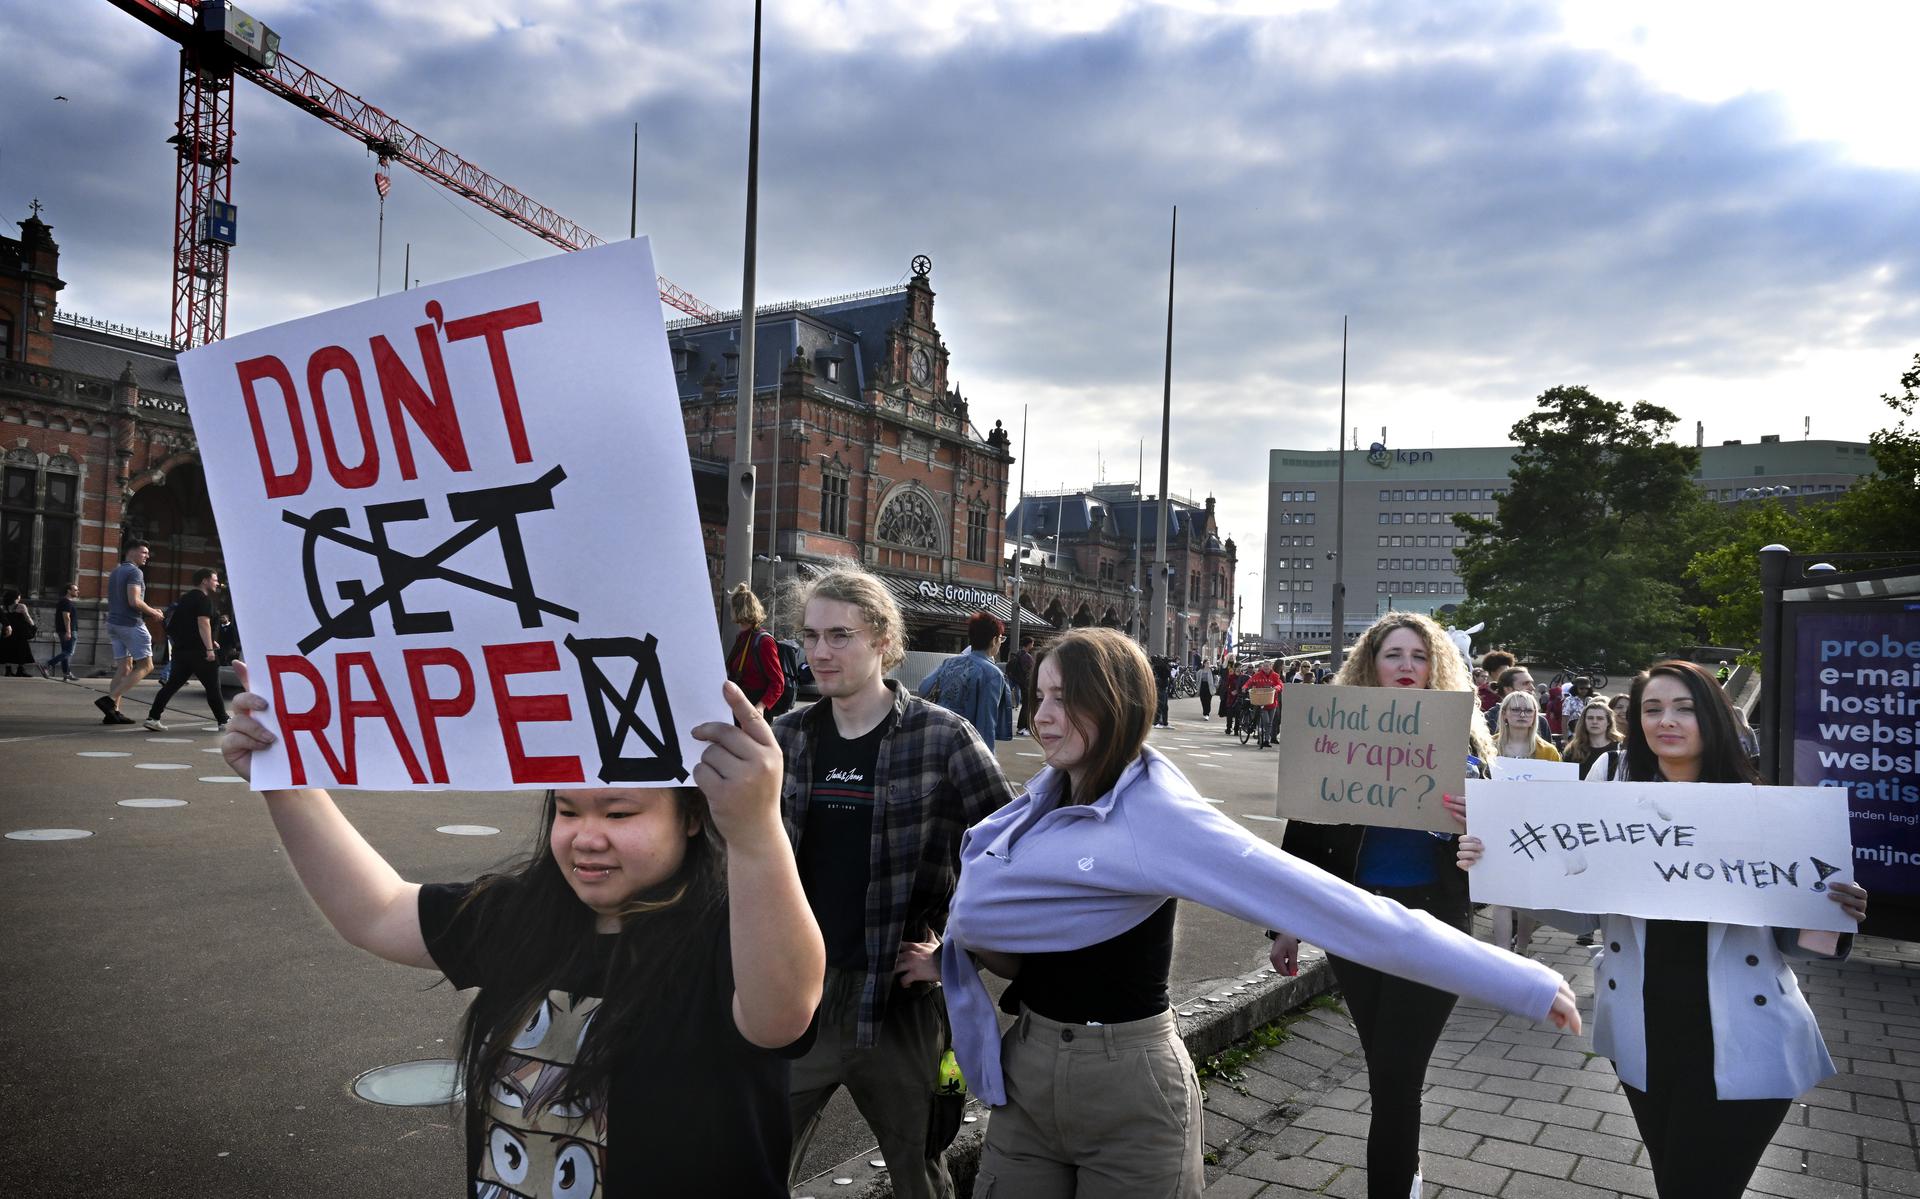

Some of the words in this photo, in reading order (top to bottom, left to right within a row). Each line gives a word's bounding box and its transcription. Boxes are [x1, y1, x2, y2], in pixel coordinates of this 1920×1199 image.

[236, 299, 542, 499] DON'T
[1396, 448, 1433, 465] kpn
[945, 585, 998, 607] Groningen
[1820, 634, 1920, 662] probe
[1819, 663, 1920, 687] e-mai
[1308, 697, 1370, 731] what
[1378, 699, 1421, 735] did
[1315, 734, 1341, 754] the
[1347, 742, 1437, 780] rapist
[1509, 820, 1697, 860] #BELIEVE
